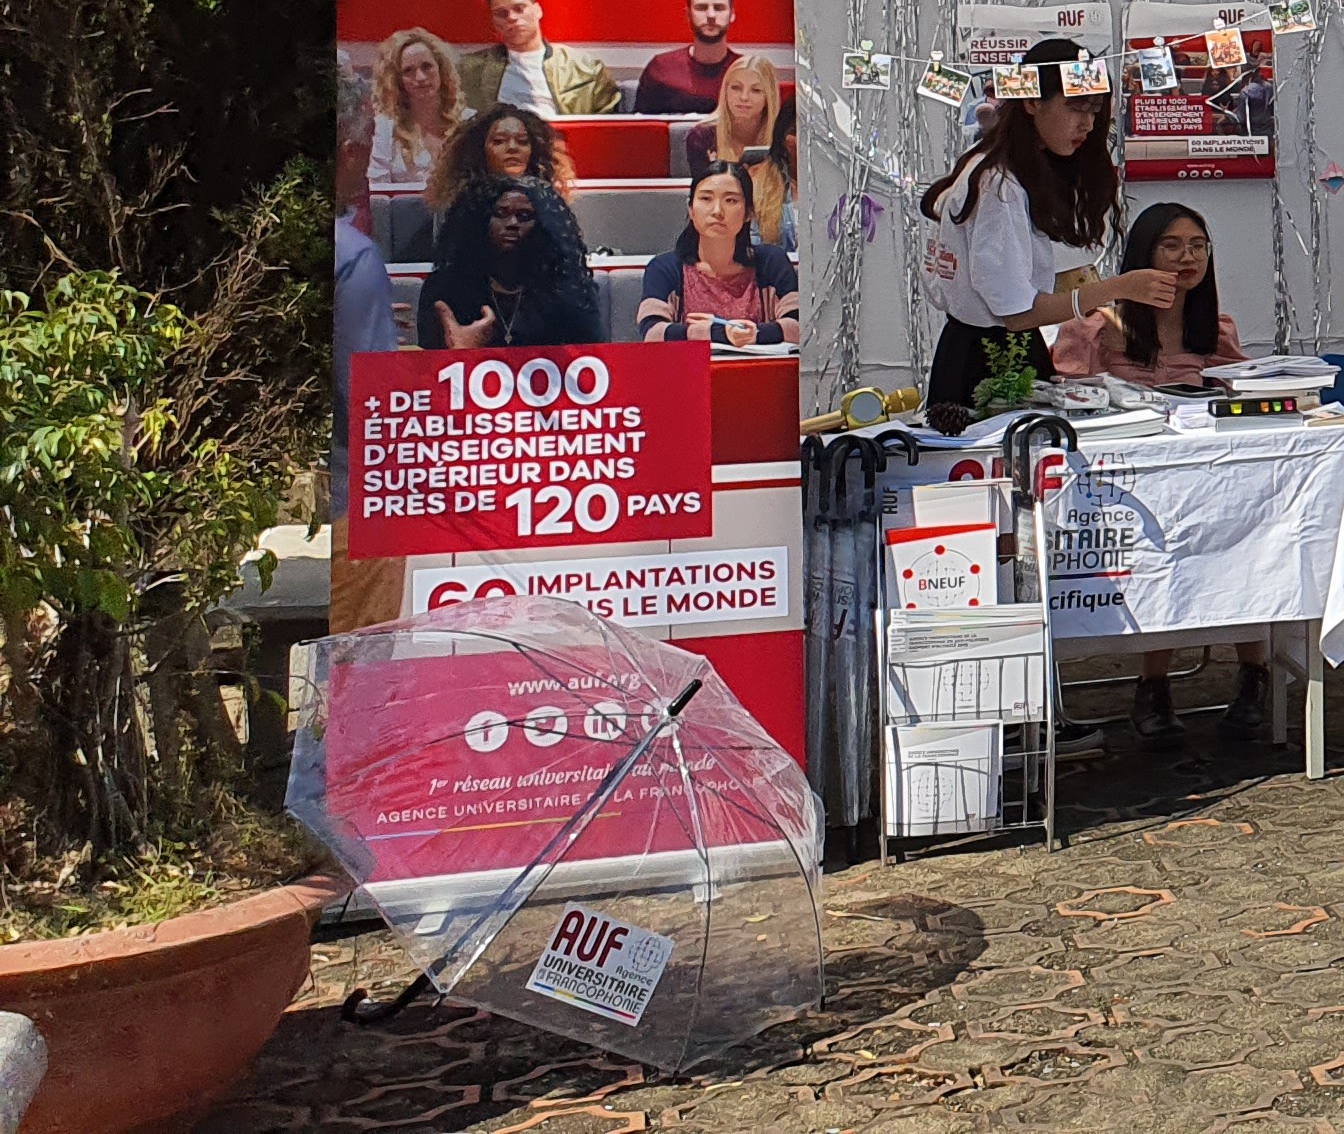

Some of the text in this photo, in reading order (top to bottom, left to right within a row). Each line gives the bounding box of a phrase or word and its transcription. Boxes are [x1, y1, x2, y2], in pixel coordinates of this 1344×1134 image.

[1057, 10, 1085, 27] AUF
[970, 37, 1028, 50] RÉUSSIR
[970, 52, 1013, 64] ENSE
[390, 390, 431, 413] DE
[438, 356, 609, 411] 1000
[364, 406, 641, 440] ÉTABLISSEMENTS
[364, 431, 646, 466] D'ENSEIGNEMENT
[363, 458, 635, 492] SUPÉRIEUR DANS
[363, 483, 701, 537] PRÈS DE 120 PAYS
[1067, 509, 1134, 526] Agence
[1047, 528, 1134, 550] SITAIRE
[528, 561, 776, 596] IMPLANTATIONS
[918, 577, 966, 591] BNEUF
[623, 596, 658, 617] LE
[667, 587, 776, 613] MONDE
[1049, 590, 1124, 613] cifique
[453, 774, 513, 793] réseau
[517, 765, 614, 789] universitai
[377, 806, 447, 824] AGENCE
[454, 794, 581, 817] UNIVERSITAIRE
[614, 791, 633, 803] LA
[551, 910, 629, 968] AUF
[543, 954, 649, 1002] UNIVERSITAIRE
[616, 965, 653, 986] Agence
[545, 971, 643, 1014] FRANCOPHONIE
